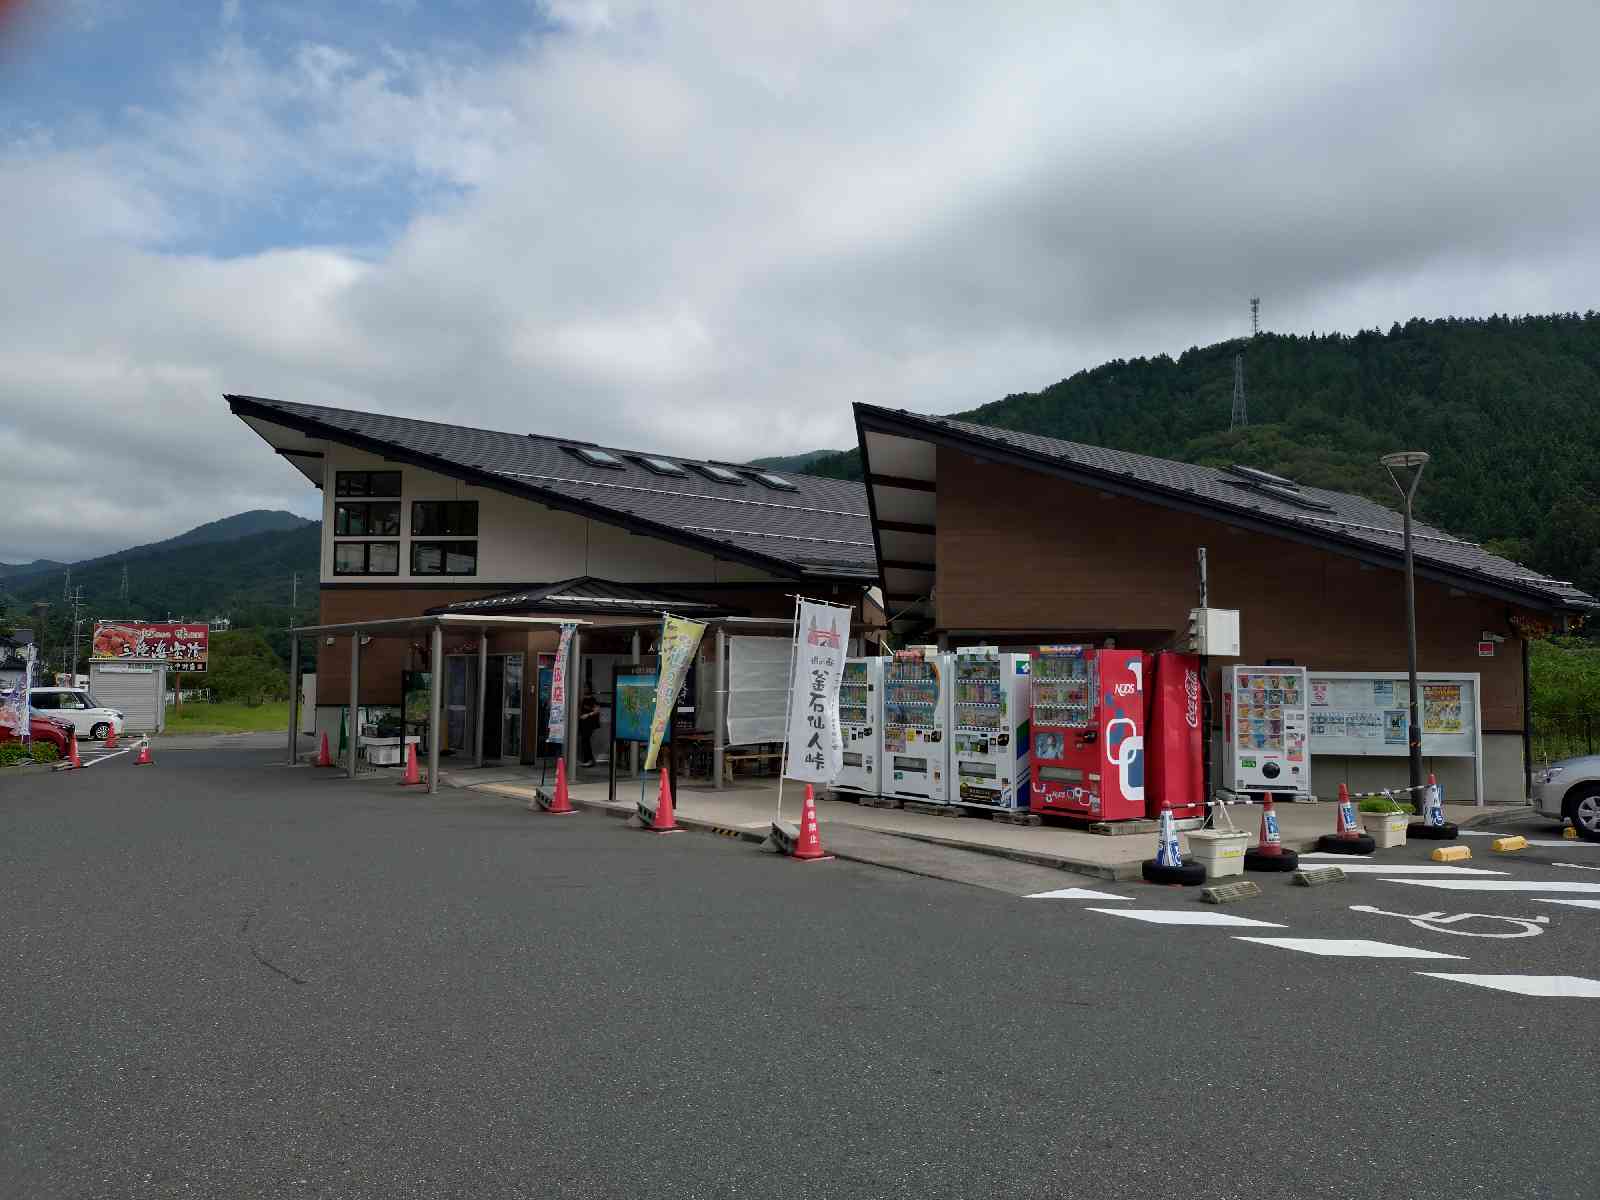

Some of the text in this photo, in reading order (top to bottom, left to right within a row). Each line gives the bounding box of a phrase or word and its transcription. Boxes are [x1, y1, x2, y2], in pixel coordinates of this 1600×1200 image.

[805, 669, 829, 770] 釜石仙人峠
[1184, 669, 1200, 727] Coca-Cola
